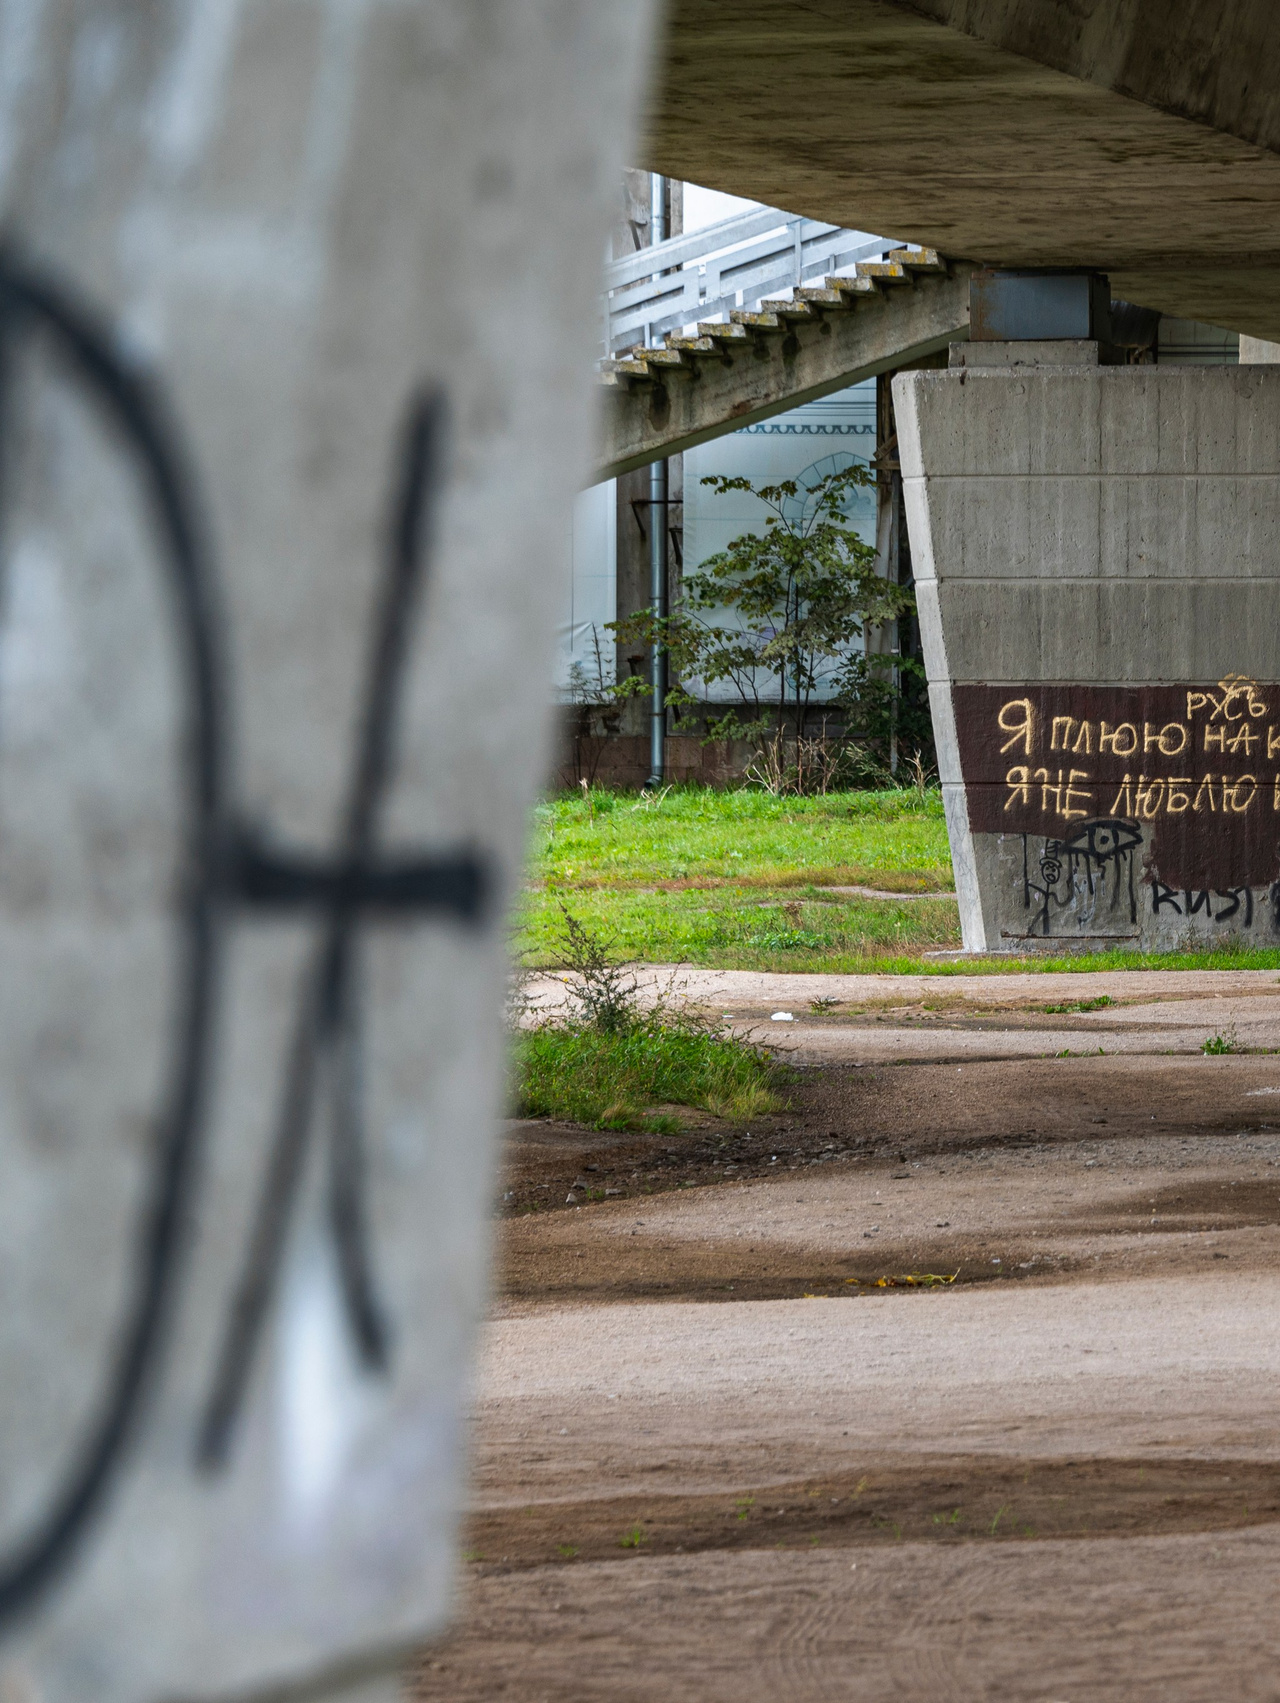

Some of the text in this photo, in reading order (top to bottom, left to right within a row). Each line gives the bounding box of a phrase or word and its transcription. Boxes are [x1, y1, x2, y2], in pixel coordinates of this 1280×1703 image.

[997, 697, 1031, 756] Я
[1203, 722, 1260, 756] НА
[1003, 765, 1029, 812] Я
[1034, 768, 1092, 820] НЕ
[1110, 772, 1258, 819] ЛЮБЛЮ
